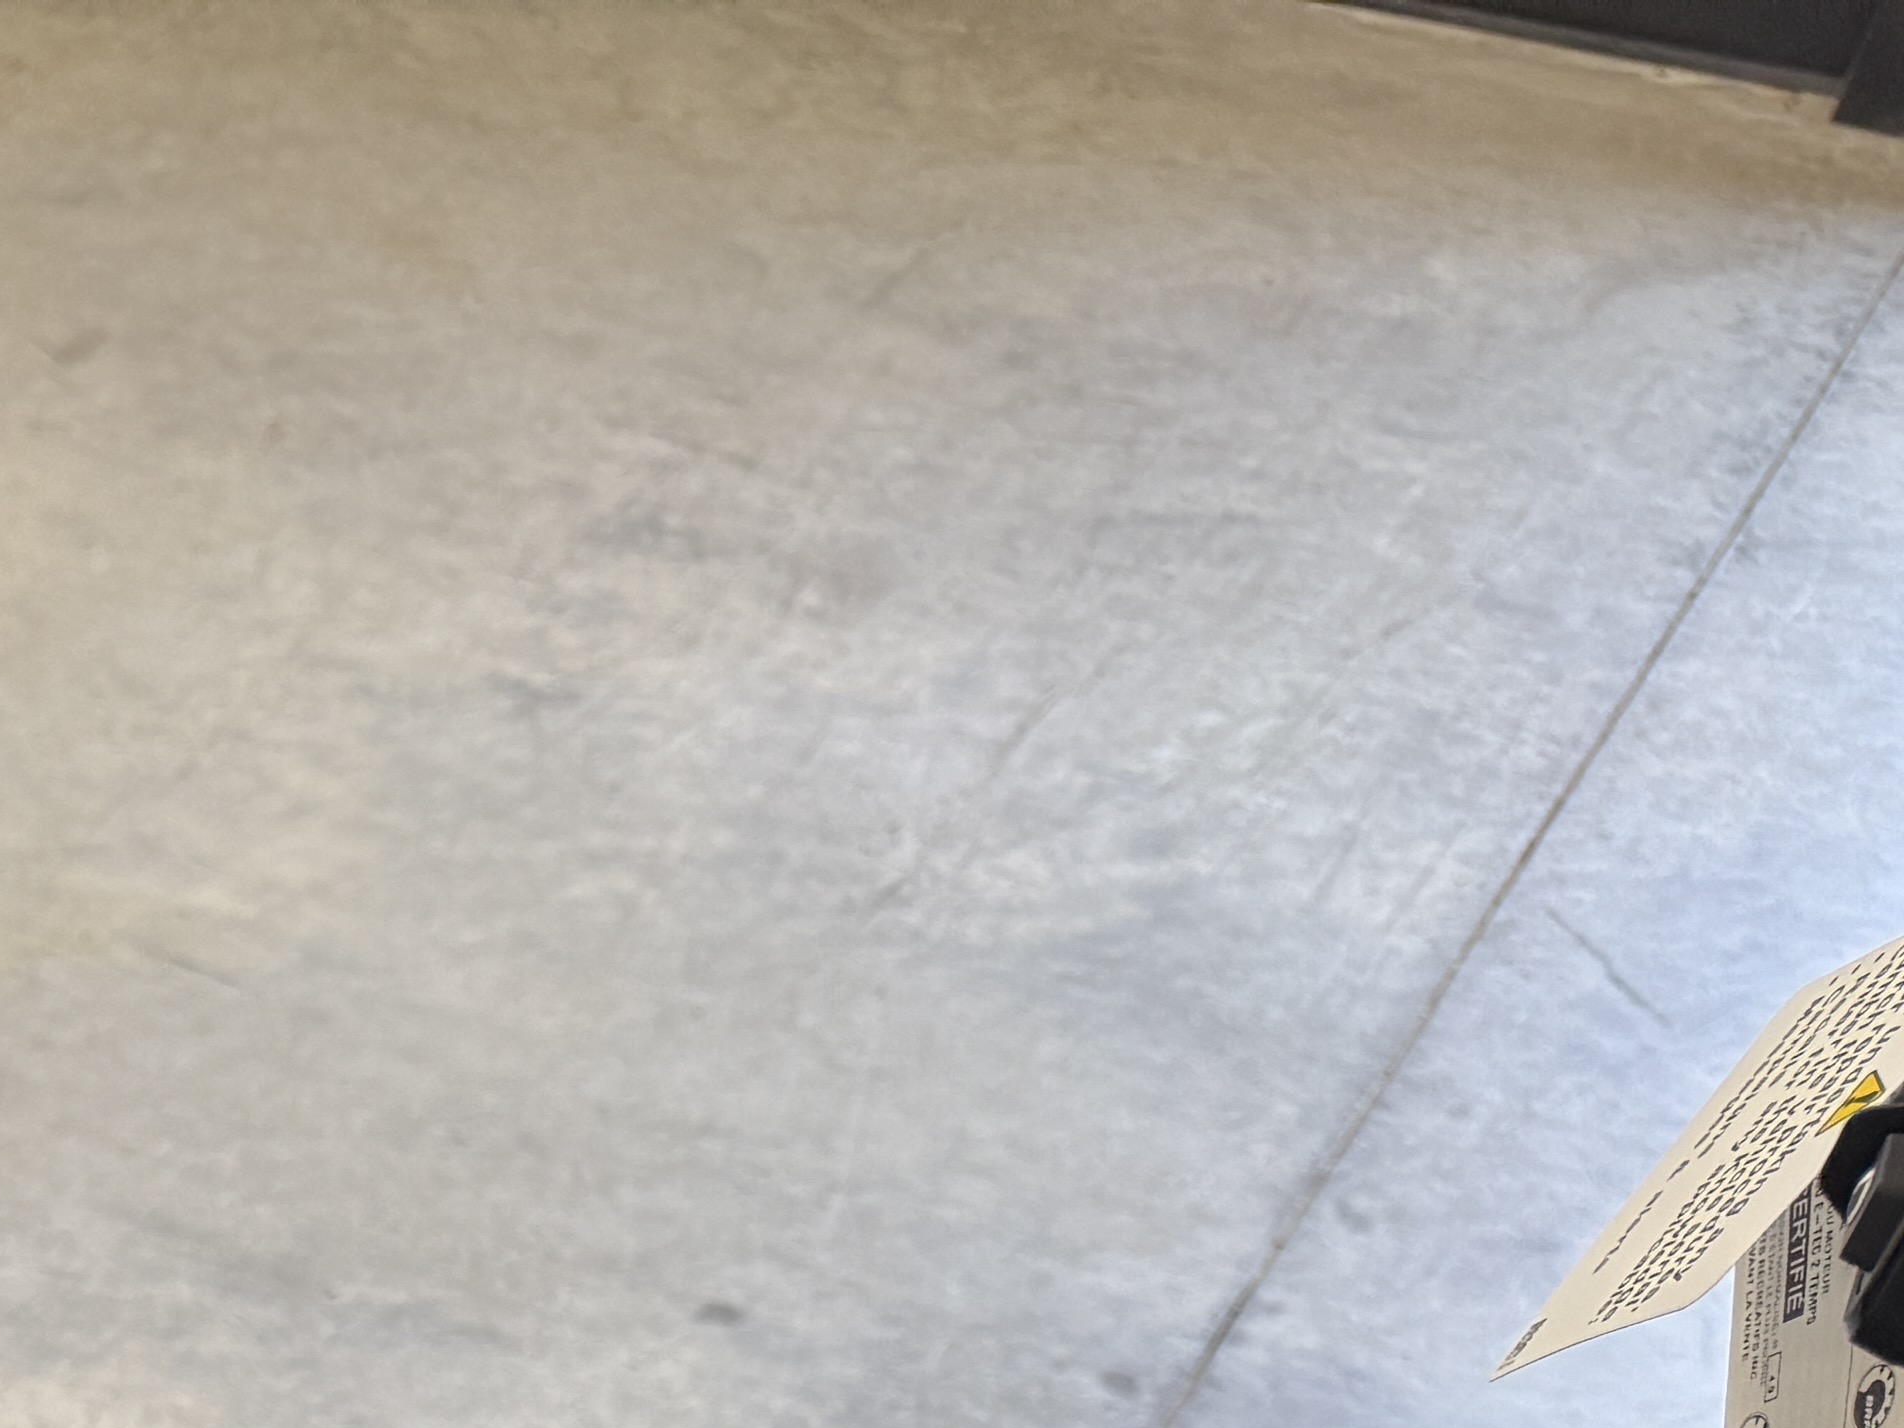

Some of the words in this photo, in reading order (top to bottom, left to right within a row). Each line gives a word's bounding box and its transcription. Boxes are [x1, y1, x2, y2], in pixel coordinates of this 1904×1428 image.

[1785, 1047, 1823, 1089] for
[1796, 1057, 1828, 1086] in
[1804, 1023, 1885, 1113] repair
[1808, 1039, 1857, 1088] the
[1726, 1025, 1902, 1216] undertaking
[1750, 1095, 1796, 1143] the
[1706, 1099, 1804, 1210] vehicle
[1602, 1153, 1748, 1321] Knowledge
[1625, 1222, 1700, 1306] serial
[1673, 1228, 1723, 1281] any
